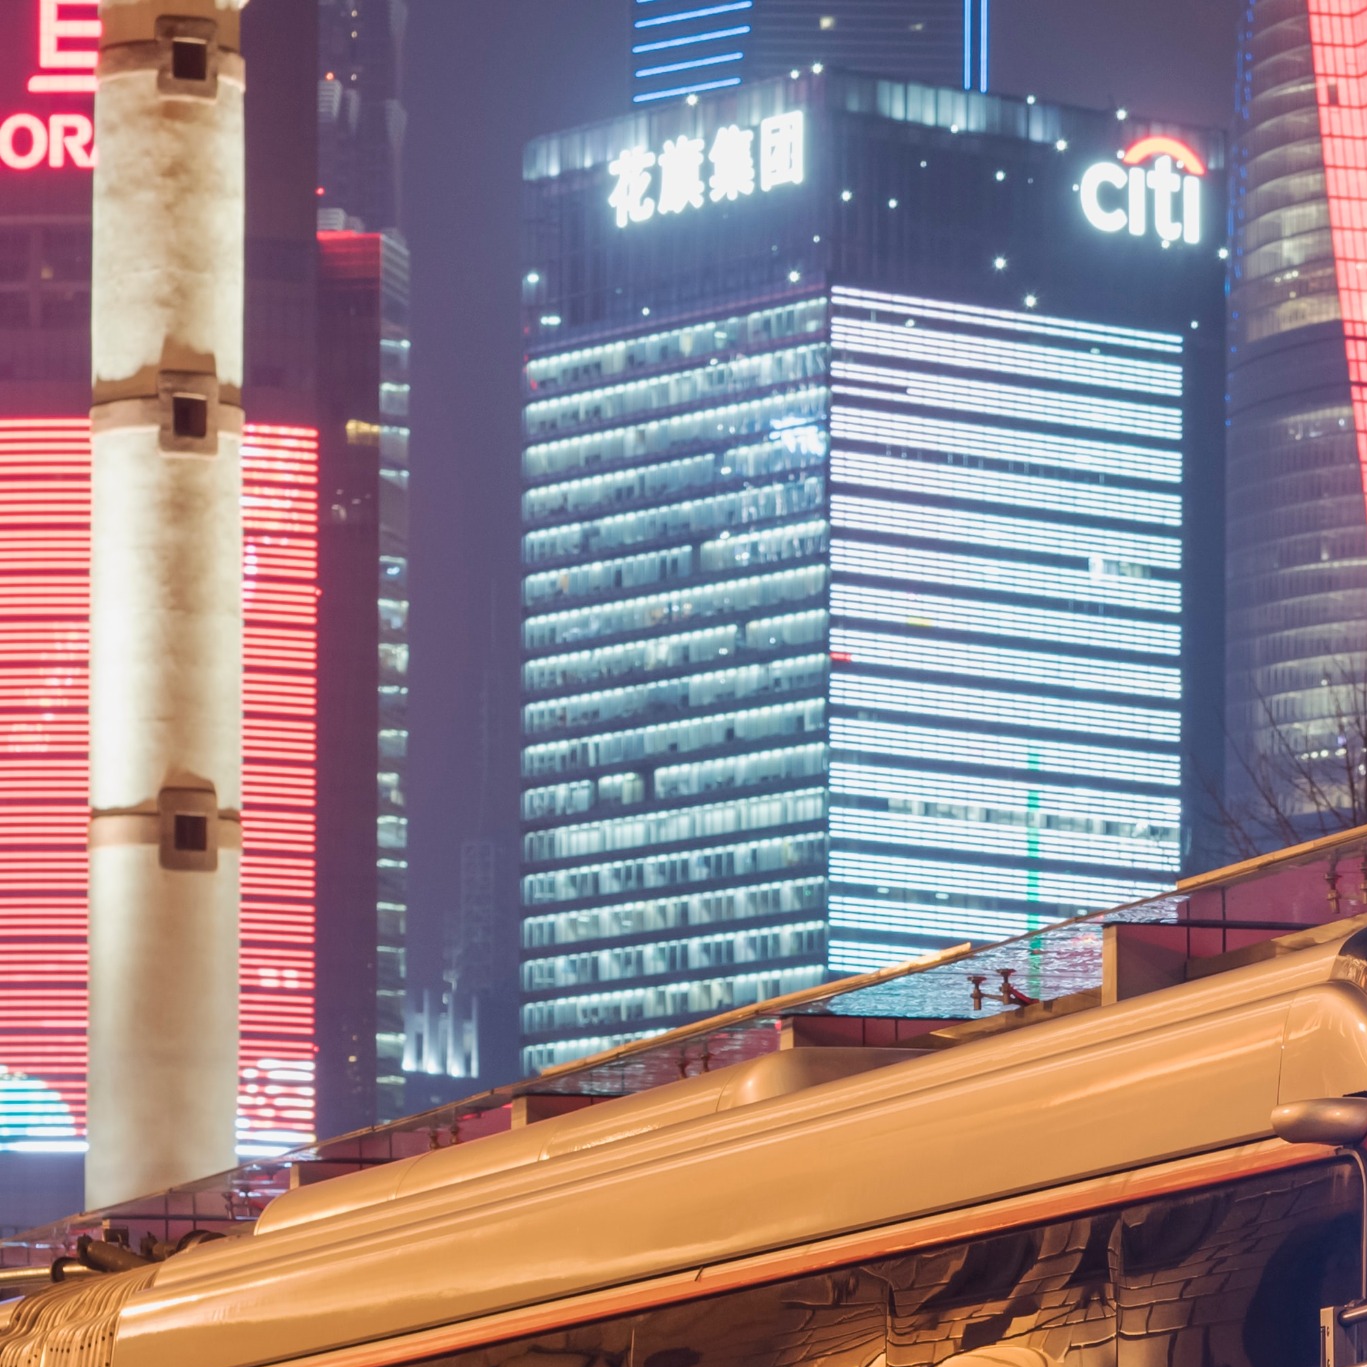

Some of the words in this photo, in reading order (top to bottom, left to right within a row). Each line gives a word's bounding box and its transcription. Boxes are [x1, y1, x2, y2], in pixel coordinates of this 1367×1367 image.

[0, 113, 98, 169] OR
[608, 110, 804, 228] 花旗集团
[1080, 155, 1200, 244] citi
